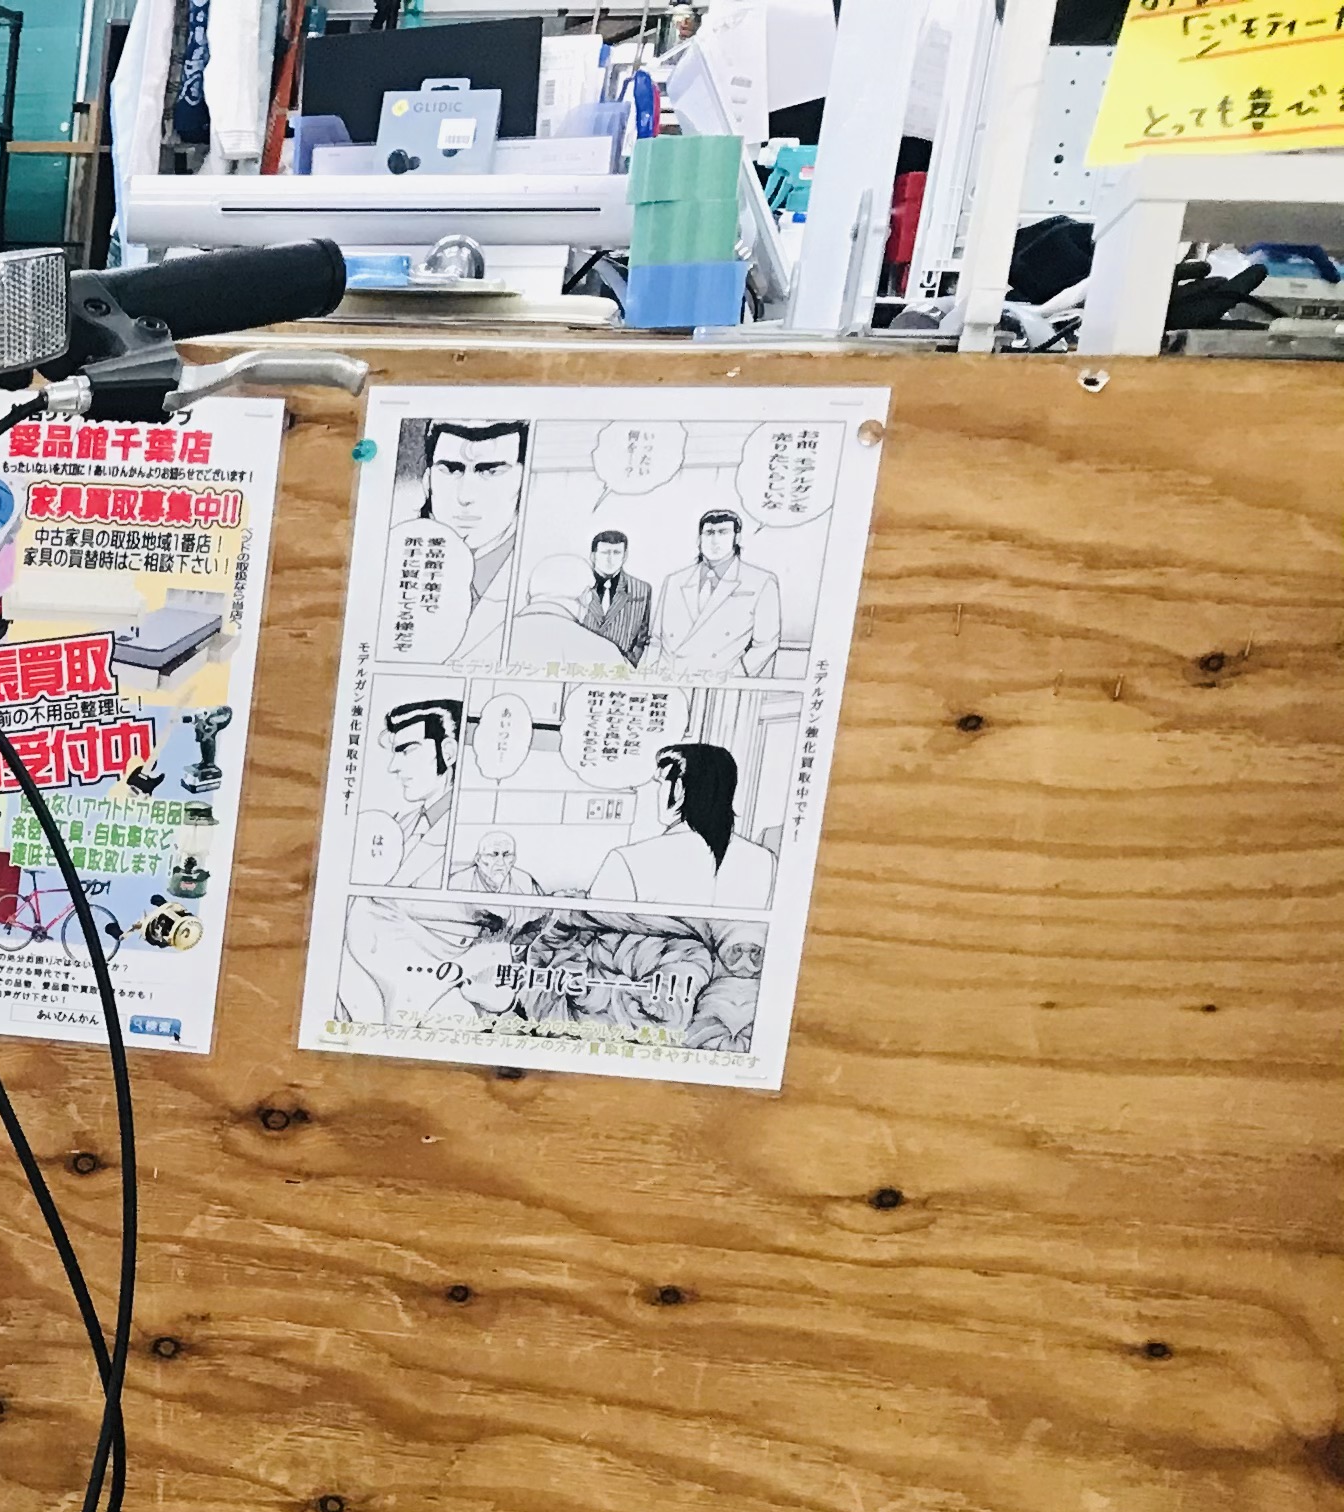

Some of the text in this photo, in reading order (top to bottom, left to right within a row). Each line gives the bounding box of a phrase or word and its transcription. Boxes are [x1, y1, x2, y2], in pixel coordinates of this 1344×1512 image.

[7, 422, 214, 465] 愛品館千葉店
[23, 546, 230, 576] 家具の買替時はご相談下さい！
[370, 834, 384, 859] はい
[36, 1009, 100, 1026] あいひんかん
